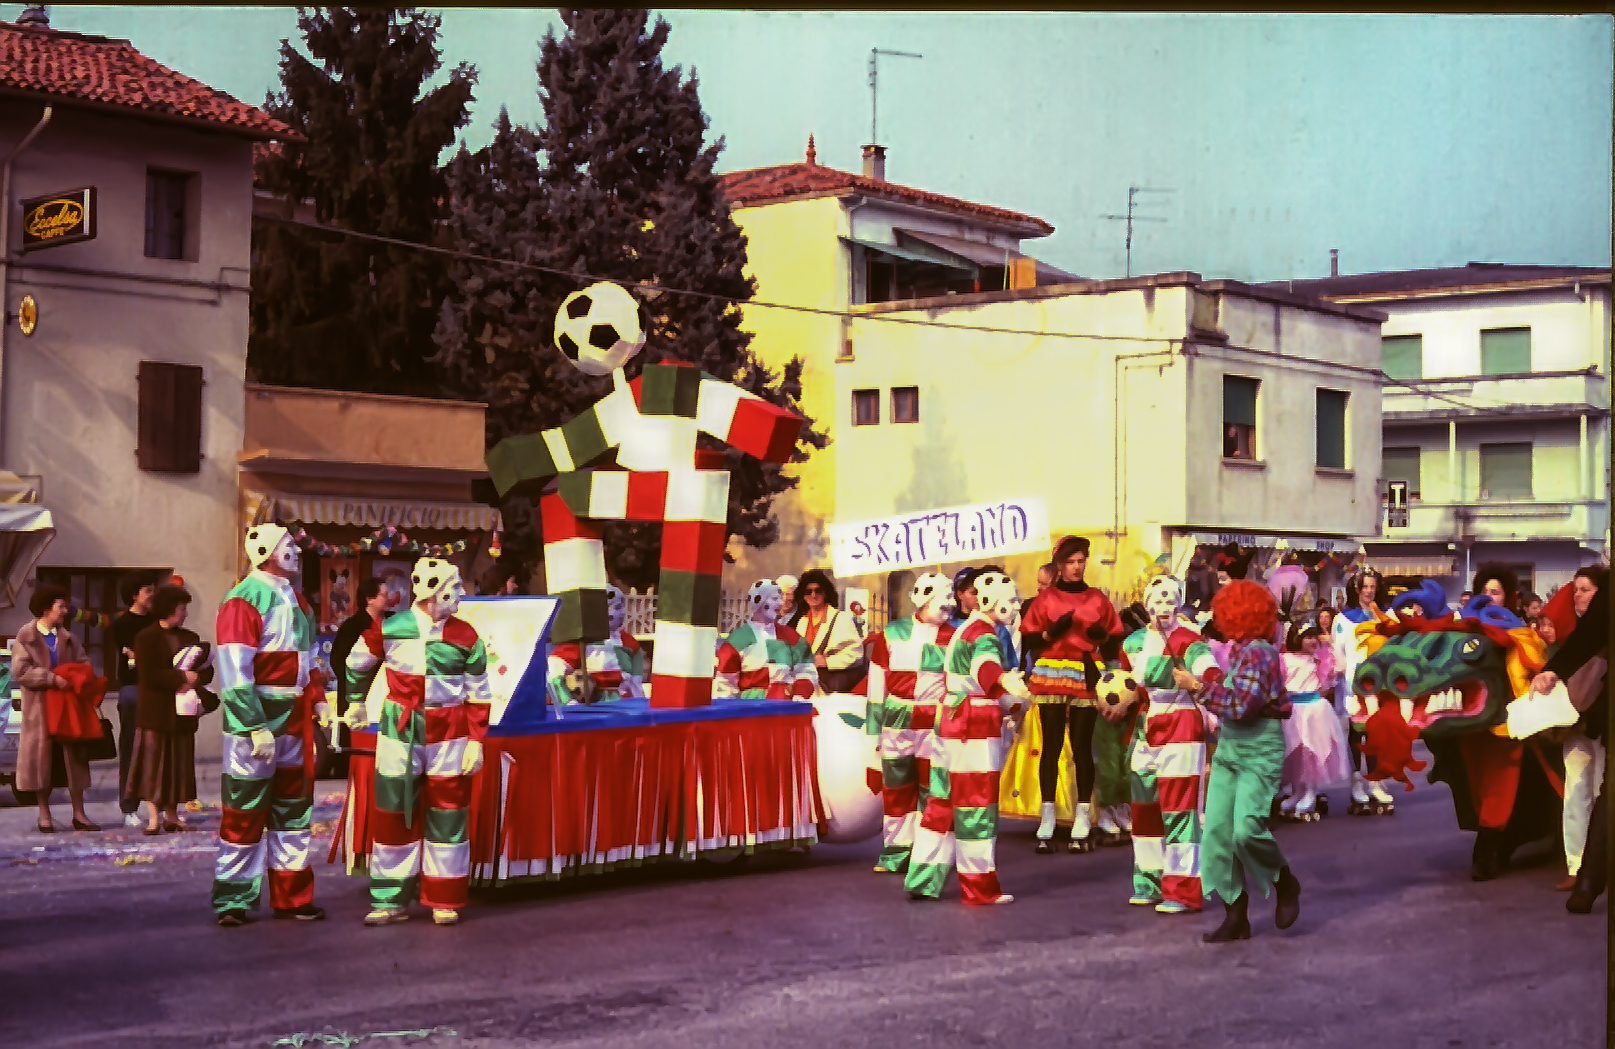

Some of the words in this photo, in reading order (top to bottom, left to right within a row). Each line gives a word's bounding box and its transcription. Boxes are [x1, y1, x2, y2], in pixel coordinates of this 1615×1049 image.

[343, 503, 441, 524] PANIFICIO
[851, 503, 1028, 565] SKATELAND
[1316, 540, 1335, 552] SHOP
